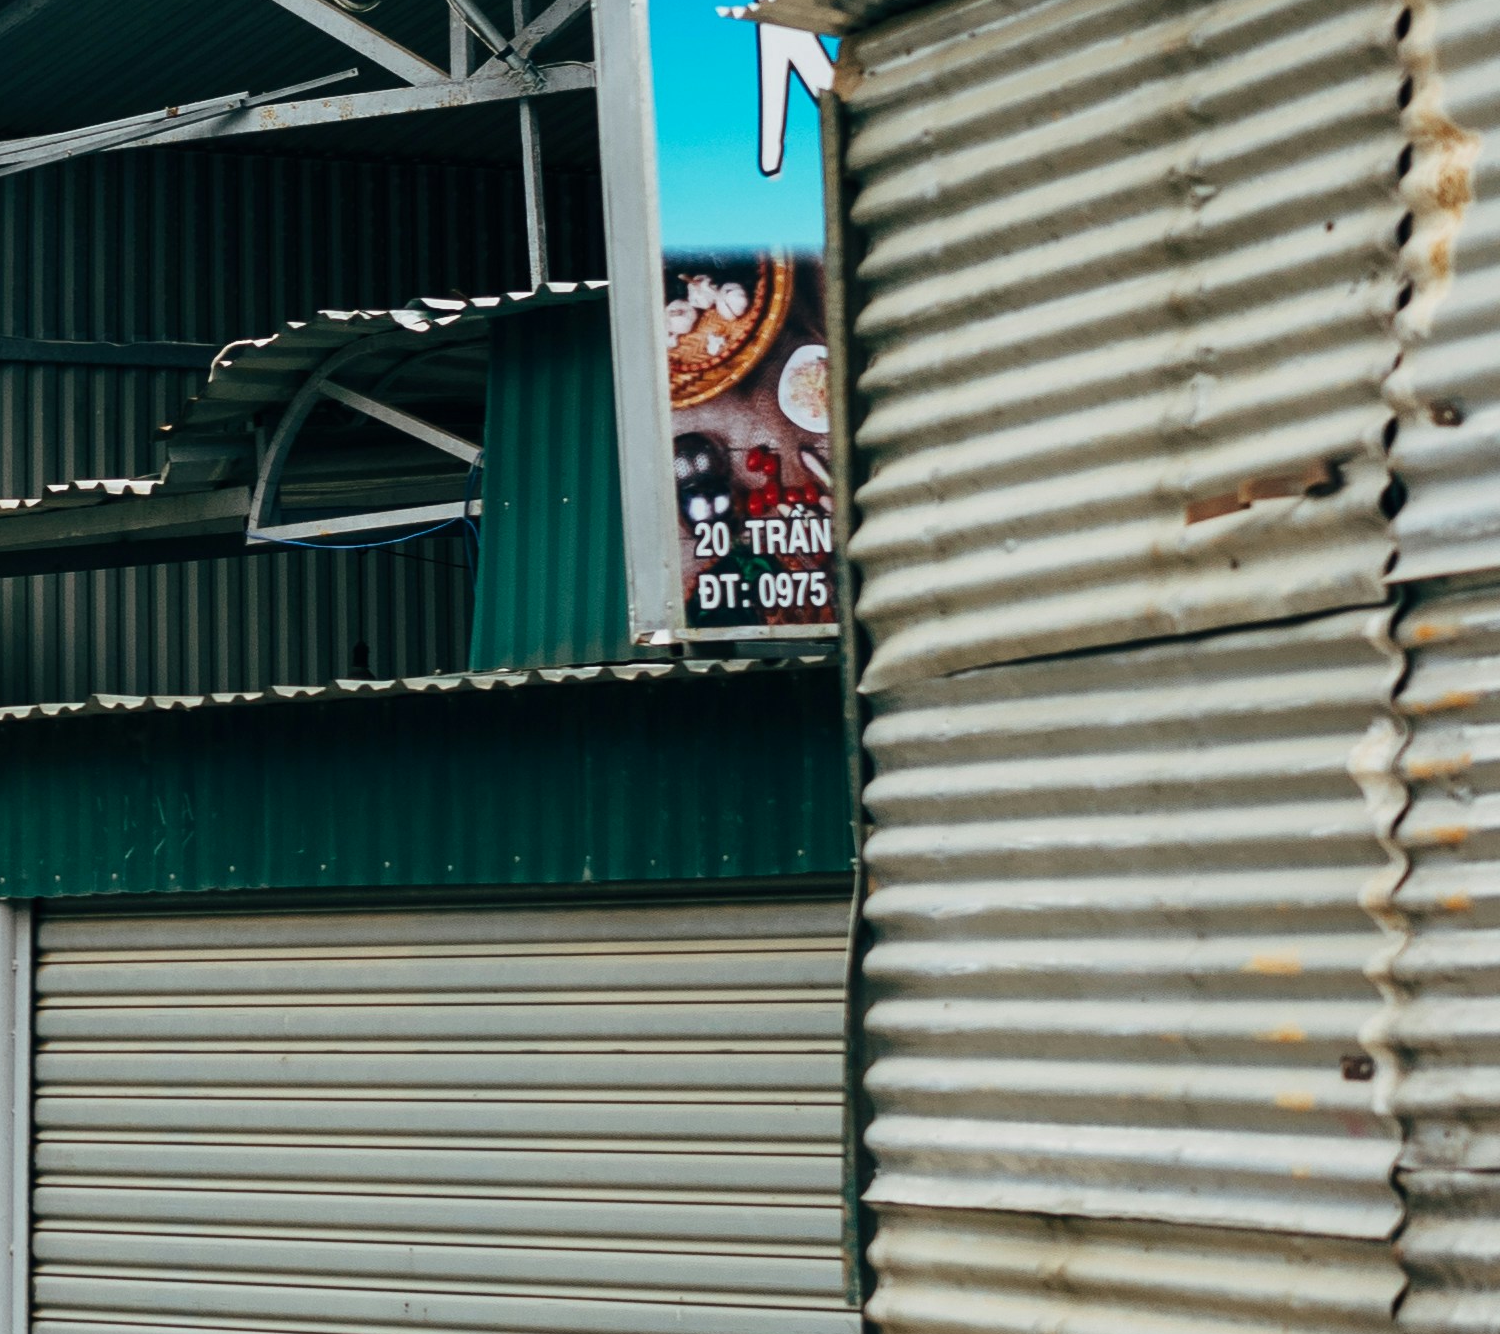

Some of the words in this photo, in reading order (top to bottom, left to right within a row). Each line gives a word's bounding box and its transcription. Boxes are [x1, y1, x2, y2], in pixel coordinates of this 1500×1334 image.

[694, 521, 731, 557] 20
[744, 504, 833, 555] TRẦN
[698, 573, 750, 609] ĐT:
[758, 571, 828, 608] 0975
